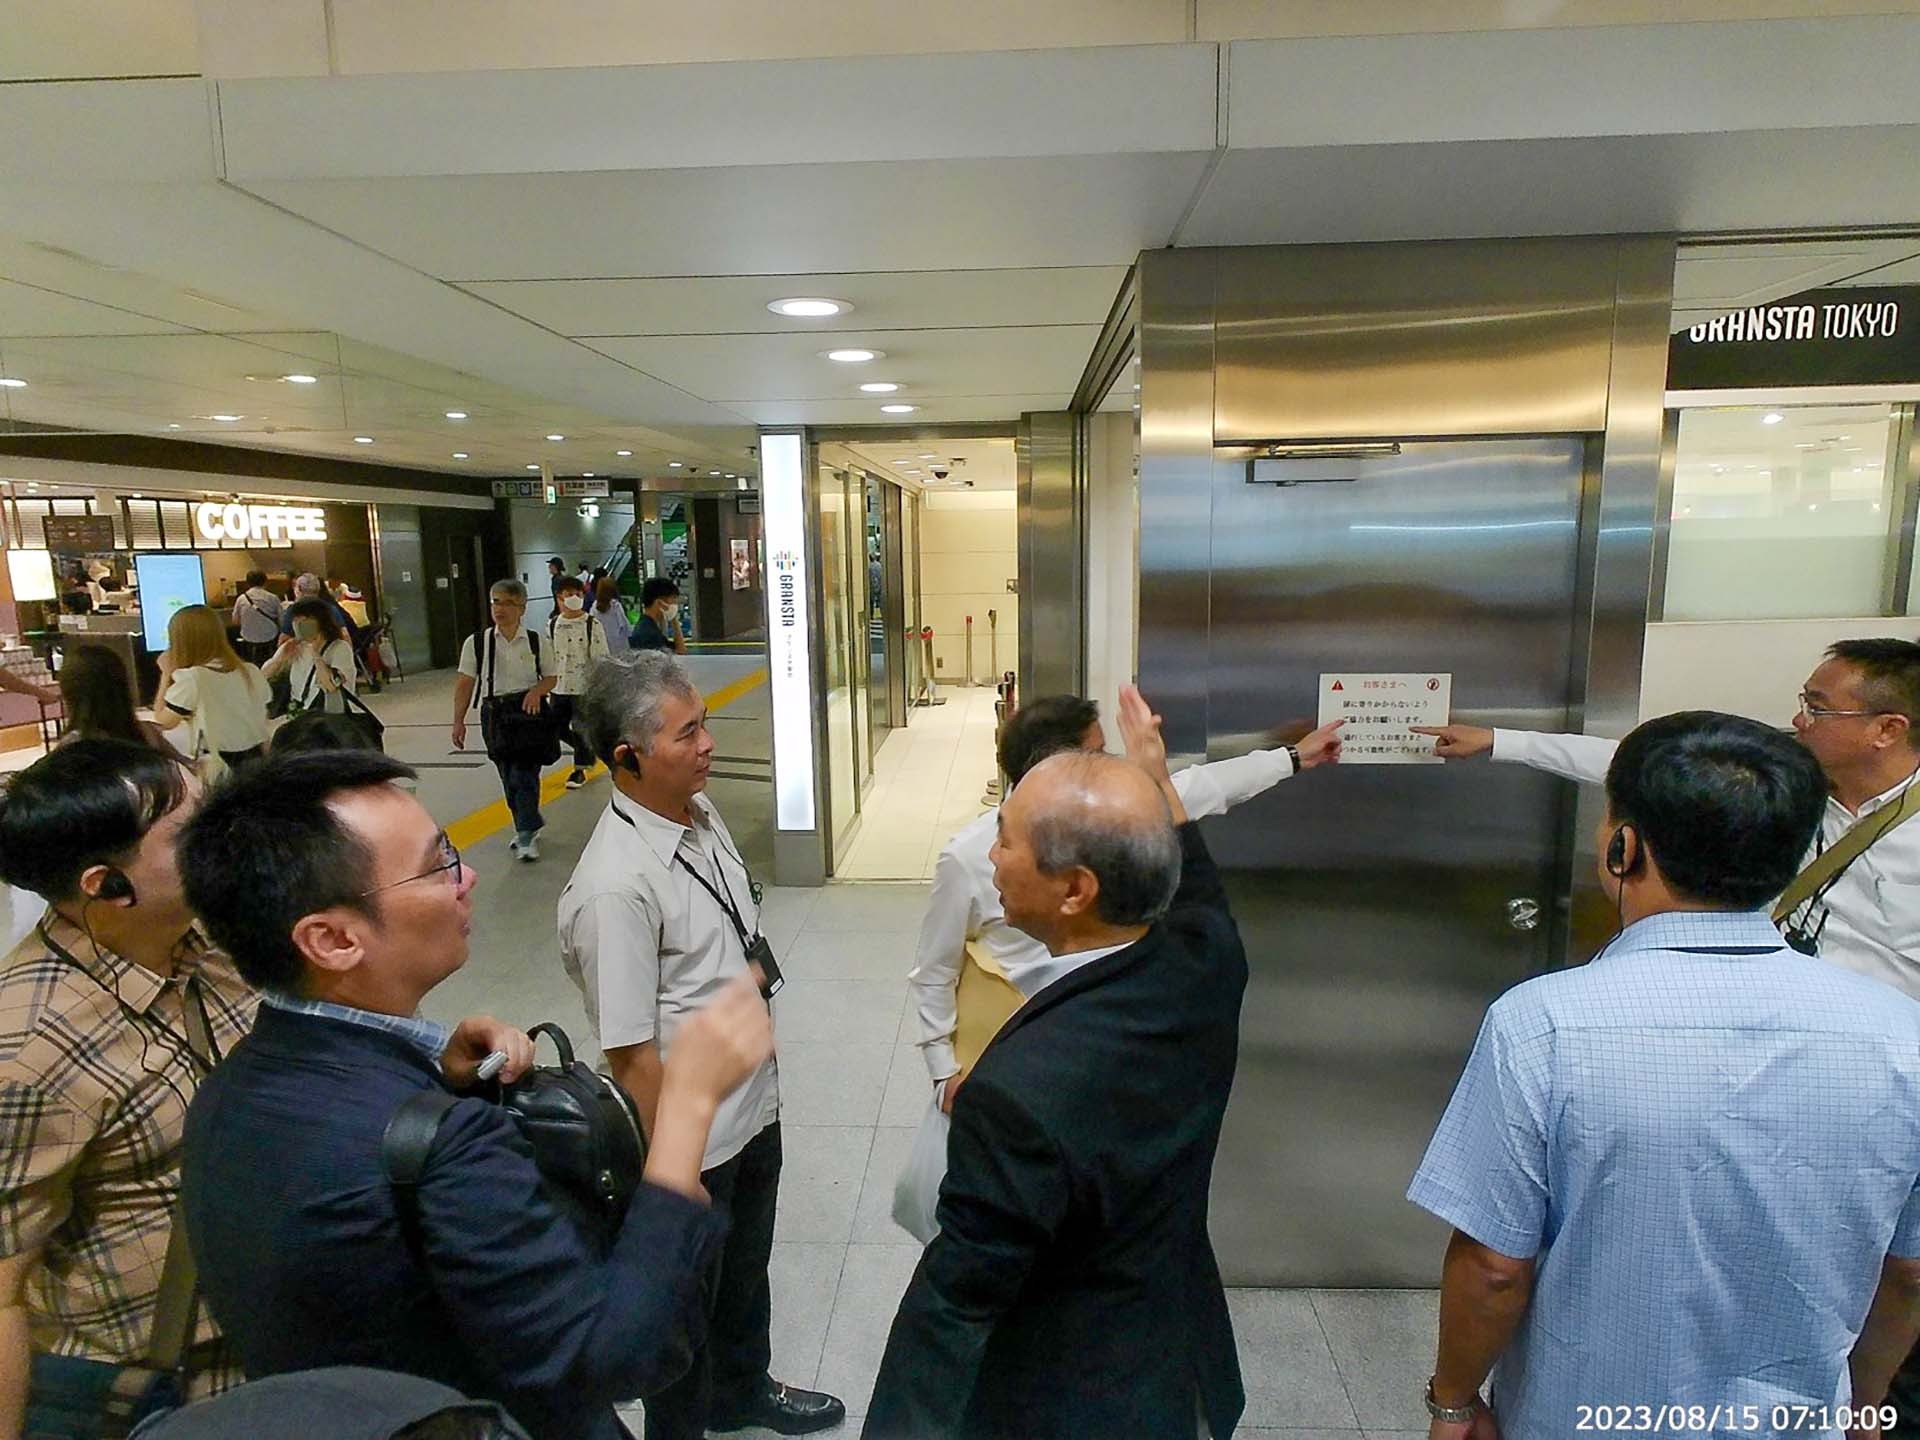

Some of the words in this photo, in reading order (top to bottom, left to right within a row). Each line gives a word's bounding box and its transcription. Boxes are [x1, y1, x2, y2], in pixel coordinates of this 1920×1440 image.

[1823, 302, 1898, 339] TOKYO
[197, 502, 327, 541] COFFEE
[779, 574, 795, 627] GRANSTA
